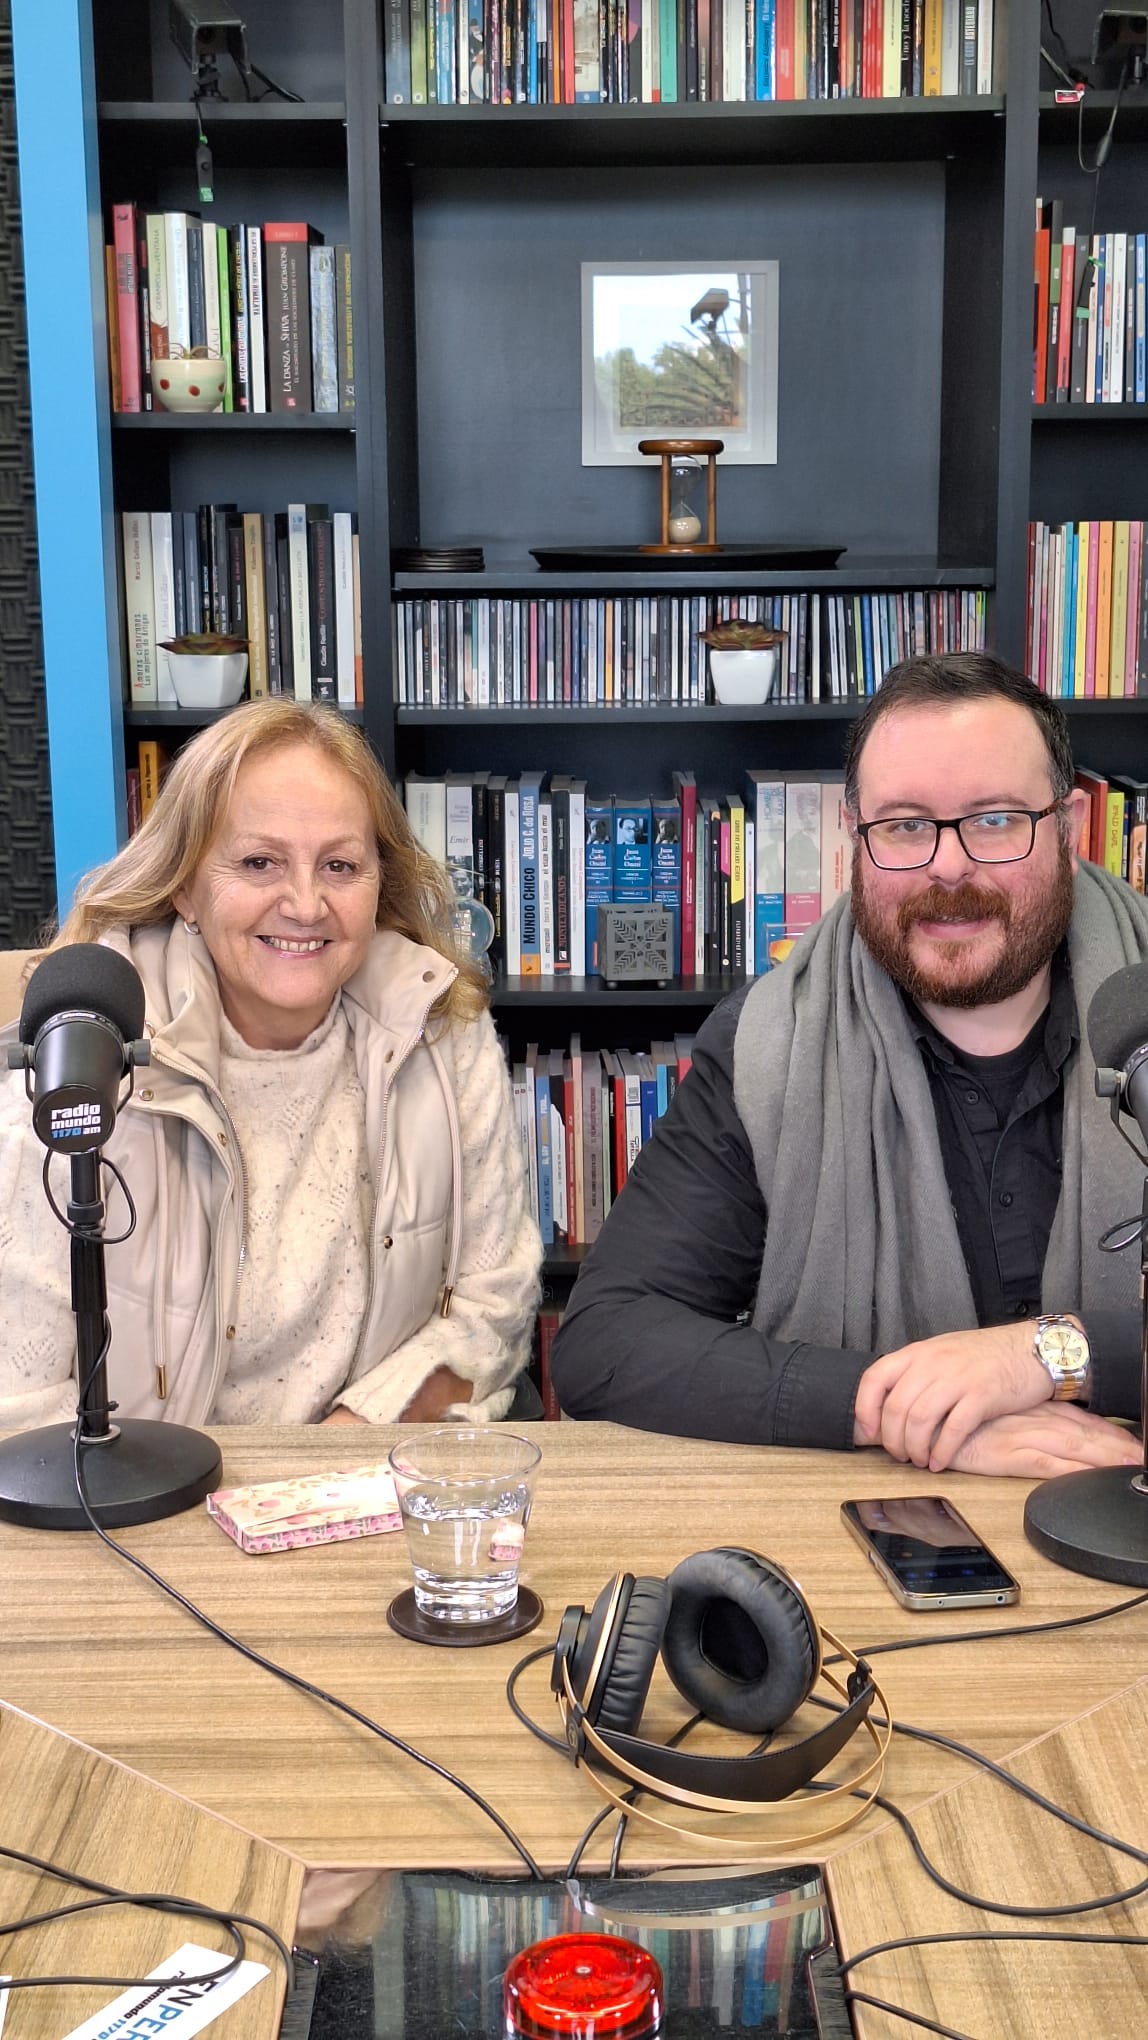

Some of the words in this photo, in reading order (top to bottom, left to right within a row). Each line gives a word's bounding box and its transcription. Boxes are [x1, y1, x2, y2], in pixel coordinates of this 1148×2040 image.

[901, 24, 910, 33] la
[900, 41, 909, 61] Uno
[280, 246, 289, 291] GROMPONE
[280, 314, 290, 342] SHIVA
[282, 350, 291, 379] DANZA
[283, 381, 292, 392] LA
[133, 614, 143, 656] cimarrones
[141, 614, 149, 637] Artigas
[134, 660, 144, 689] Amores
[521, 796, 534, 817] ROSA
[522, 828, 534, 837] C.
[522, 838, 535, 860] JULIO
[522, 867, 535, 901] CHICO
[557, 875, 567, 948] MONTEVIDEANOS
[522, 904, 536, 944] MUNDO
[51, 1103, 100, 1120] radio
[51, 1115, 101, 1130] mundo
[52, 1127, 82, 1139] 1170
[83, 1127, 101, 1135] am
[97, 2018, 127, 2039] 1170
